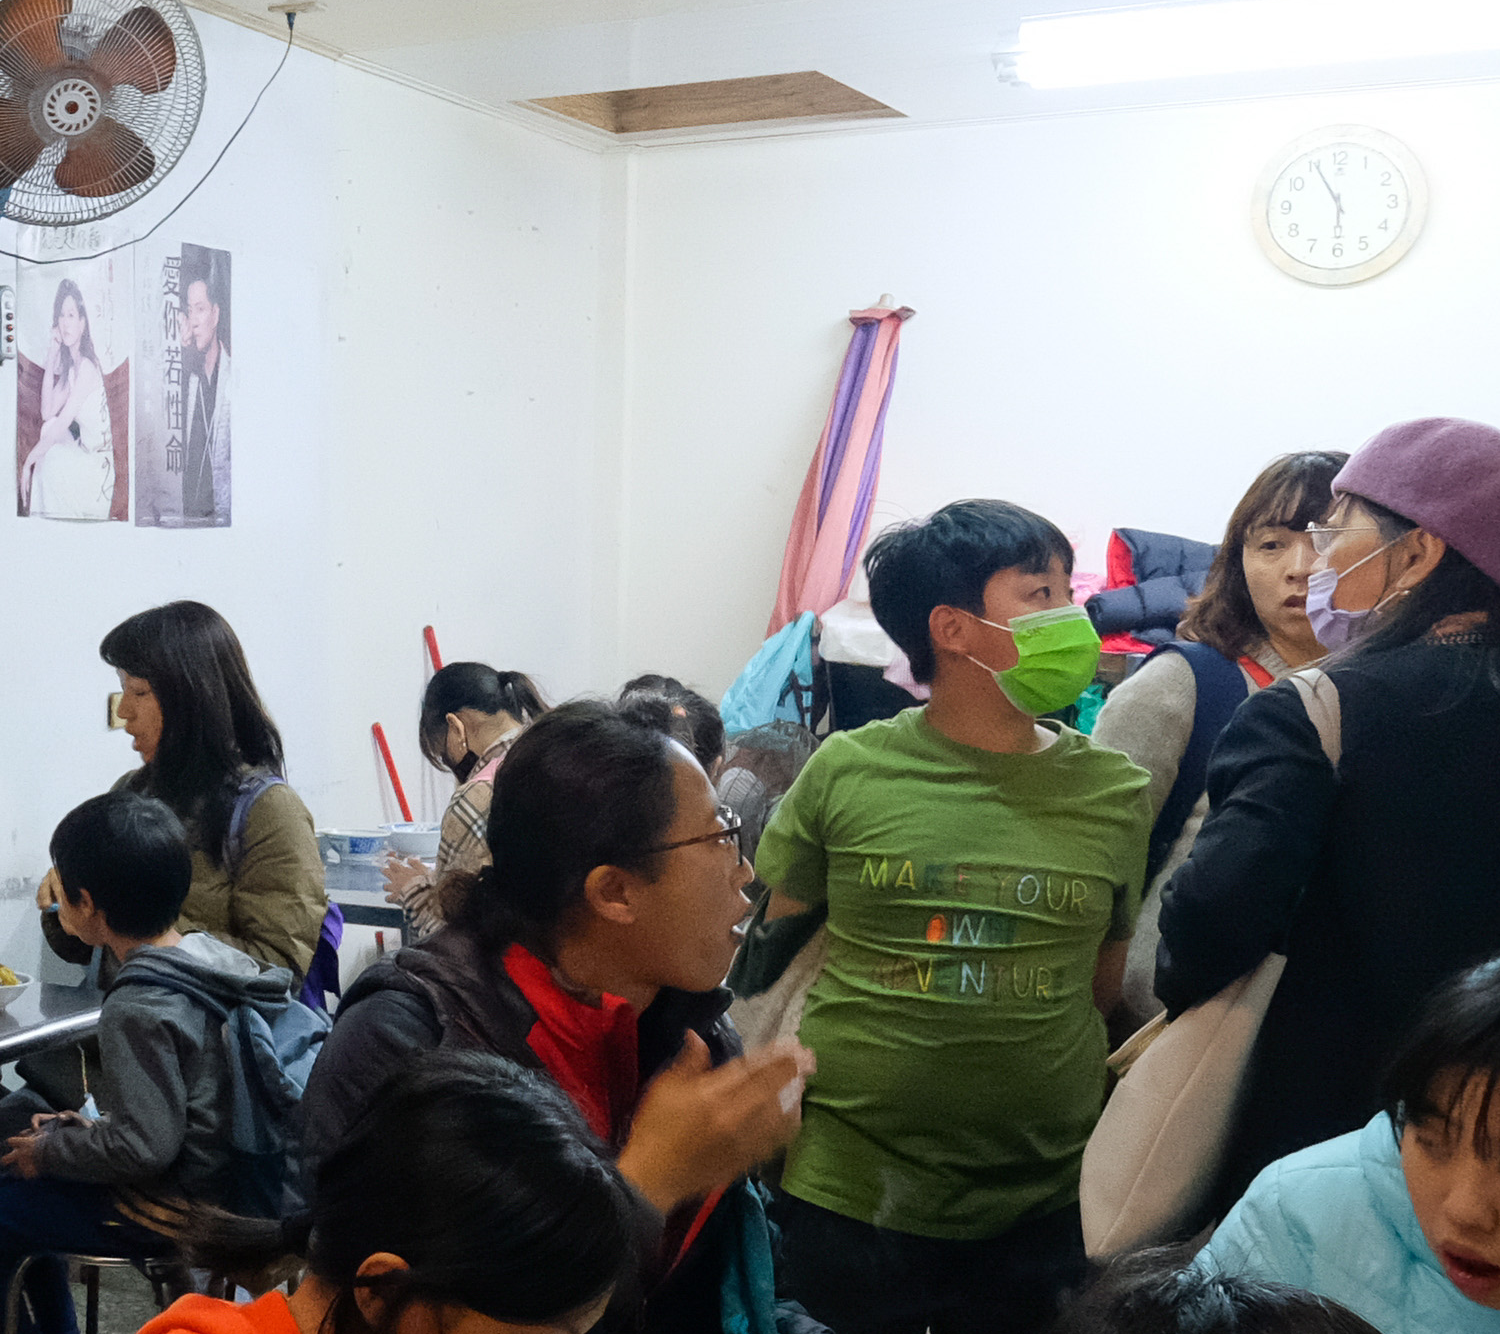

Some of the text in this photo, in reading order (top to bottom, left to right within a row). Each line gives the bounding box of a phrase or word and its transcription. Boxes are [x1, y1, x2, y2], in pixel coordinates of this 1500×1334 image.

[1333, 151, 1348, 166] 12
[1363, 156, 1368, 169] 1
[1289, 176, 1305, 192] 10
[1380, 171, 1392, 186] 2
[1280, 200, 1292, 215] 9
[1387, 194, 1399, 209] 3
[1287, 223, 1300, 238] 8
[1377, 218, 1388, 232] 4
[1306, 238, 1318, 253] 7
[1331, 243, 1343, 258] 6
[1358, 236, 1369, 251] 5
